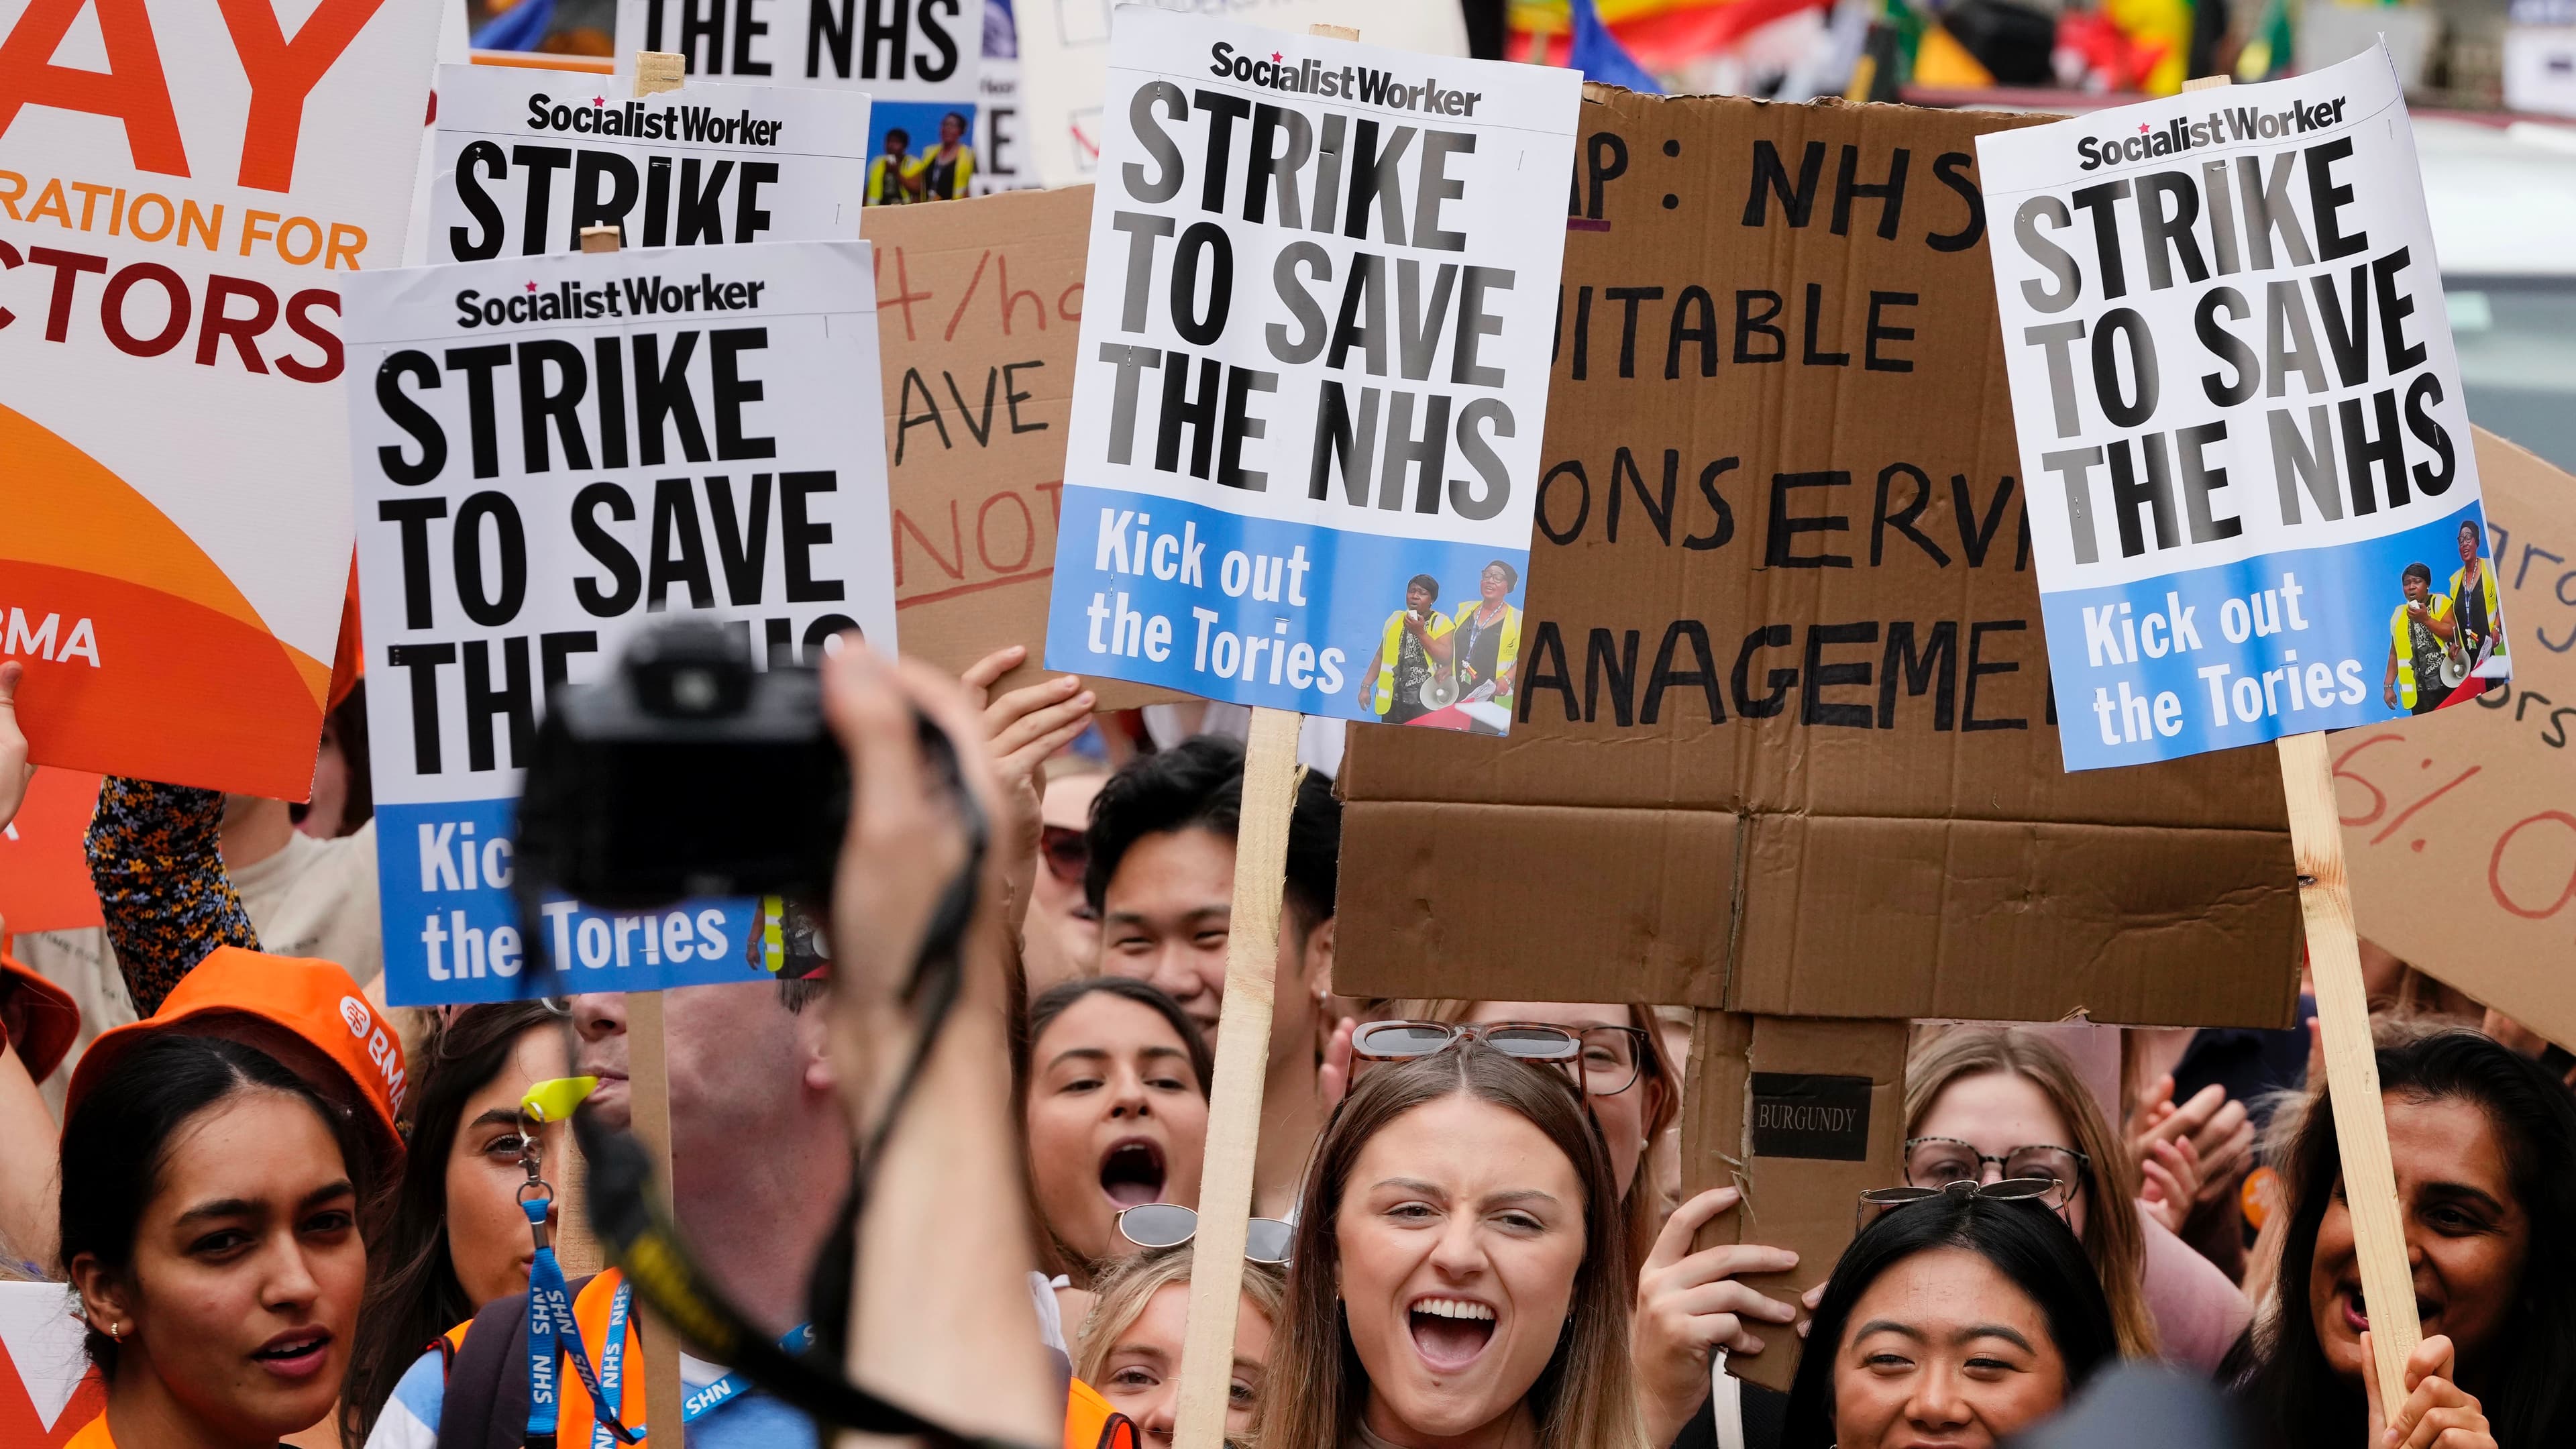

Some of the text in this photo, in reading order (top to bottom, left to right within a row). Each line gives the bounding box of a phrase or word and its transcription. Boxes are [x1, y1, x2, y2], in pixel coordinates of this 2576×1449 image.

[806, 0, 960, 82] NHS
[450, 140, 778, 262] STRIKE
[1122, 81, 1477, 252] STRIKE
[1741, 140, 1987, 252] NHS
[239, 209, 368, 270] FOR
[2014, 136, 2369, 313] STRIKE
[1113, 210, 1516, 388] TO SAVE
[2024, 246, 2427, 439] TO SAVE
[376, 327, 776, 486] STRIKE
[885, 360, 1049, 466] AVE
[1098, 341, 1516, 521] THE NHS
[2041, 372, 2456, 565] THE NHS
[379, 471, 845, 630] TO SAVE
[1095, 507, 1309, 606] Kick out
[0, 607, 101, 667] MA
[1087, 592, 1346, 694] the Tories
[2082, 572, 2308, 666] Kick out
[1519, 619, 2058, 732] ANAGEME
[2094, 651, 2367, 746] the Tories
[422, 900, 729, 983] the Tories
[368, 1026, 407, 1122] BMA
[1759, 1104, 1856, 1133] BURGUNDY
[532, 1287, 550, 1334] NHS
[546, 1290, 576, 1334] NHS
[611, 1283, 630, 1326] NHS
[532, 1355, 553, 1403] NHS
[571, 1354, 599, 1395] NHS
[603, 1343, 620, 1388] NHS
[686, 1379, 732, 1415] NHS
